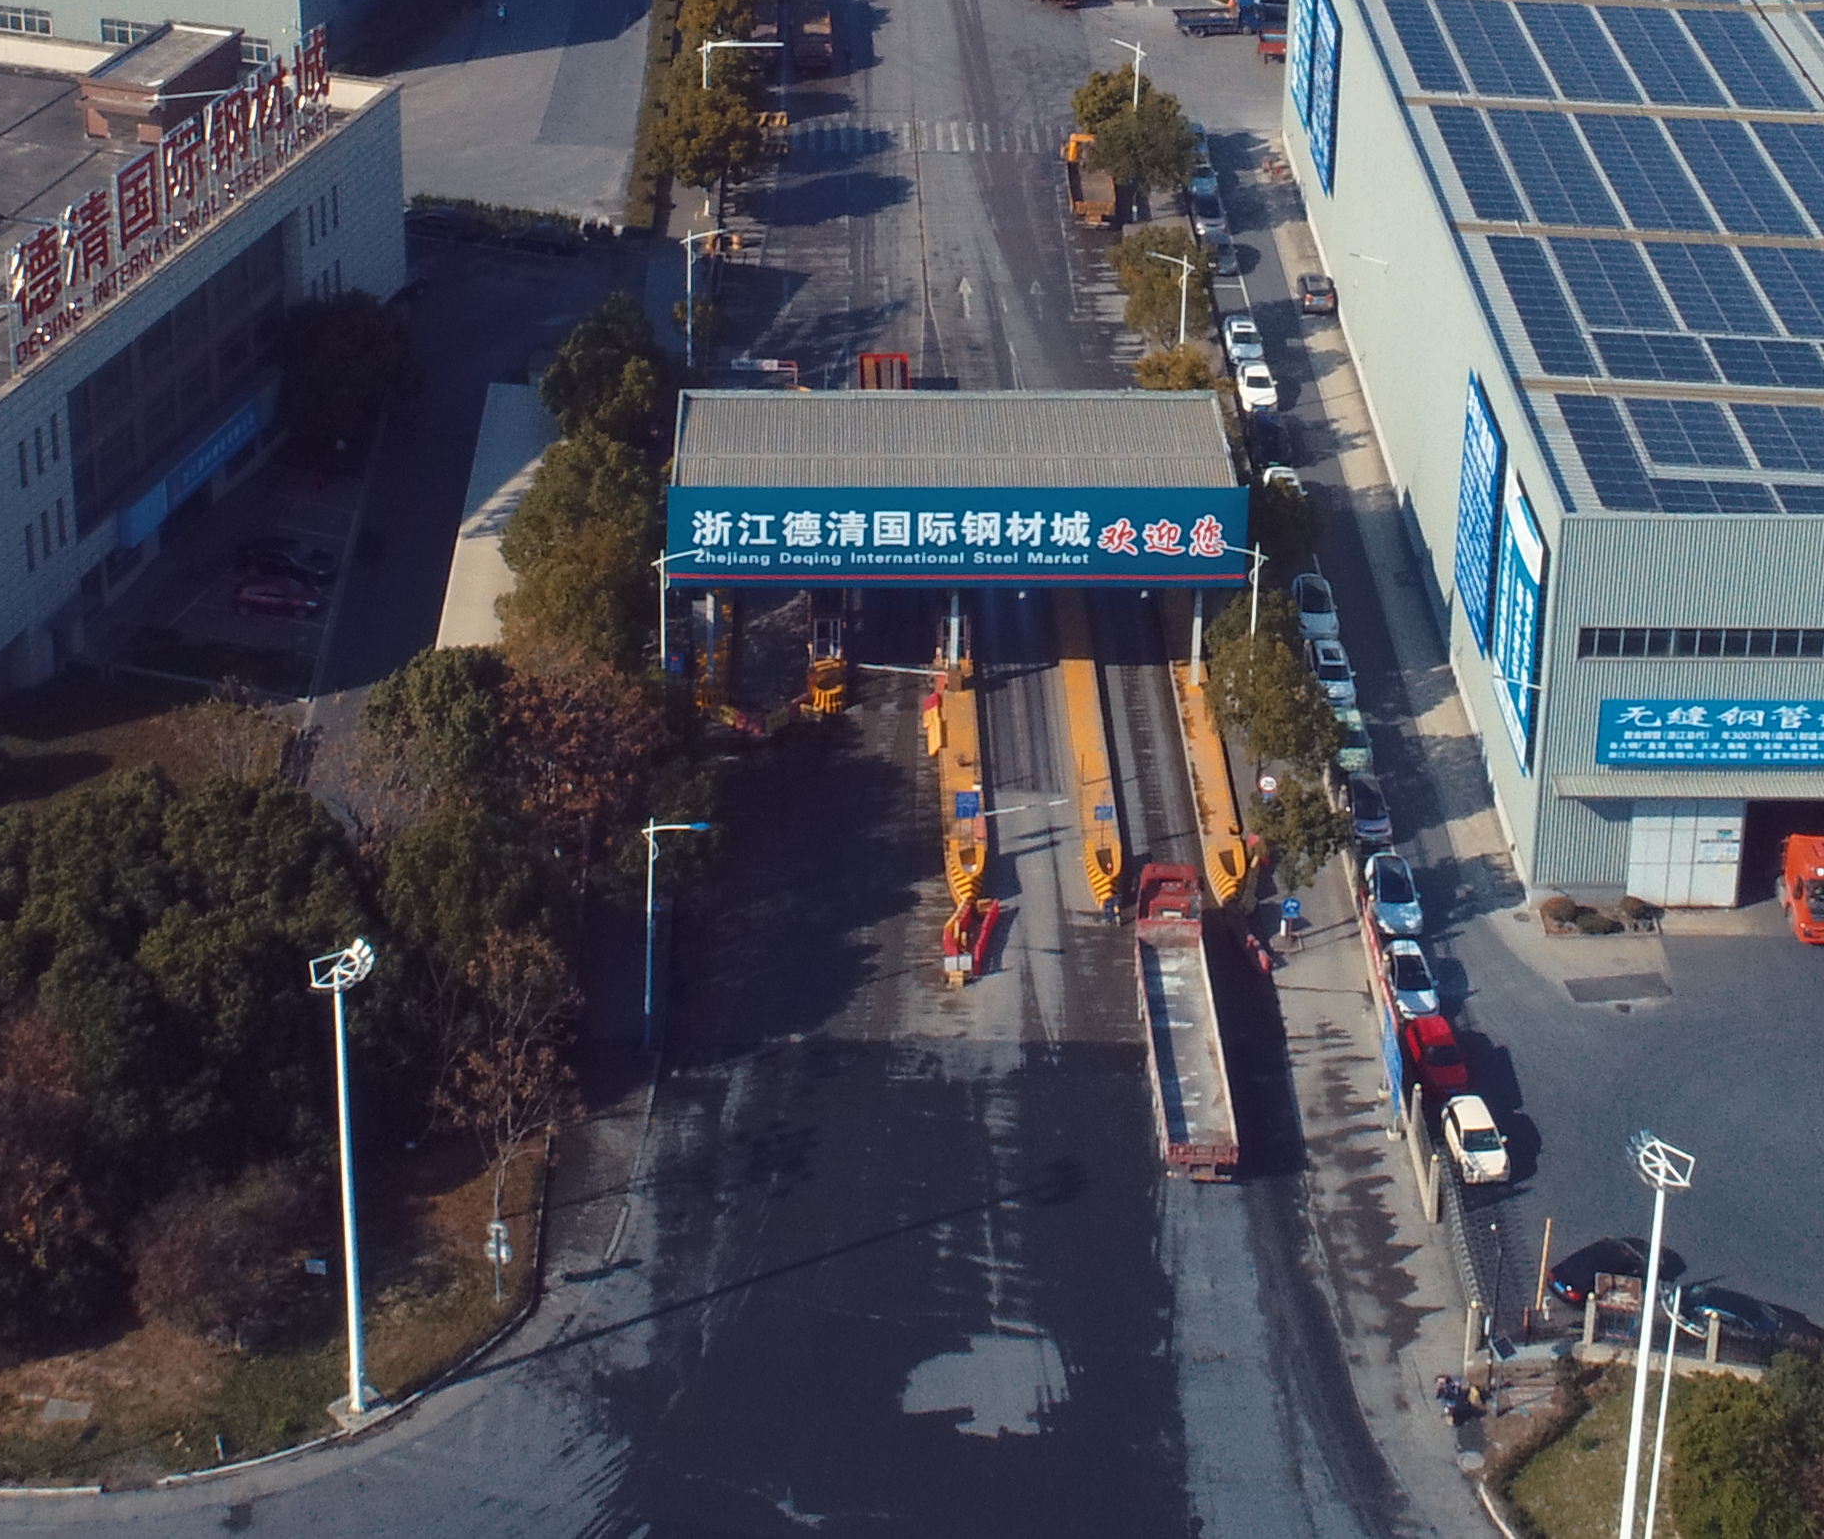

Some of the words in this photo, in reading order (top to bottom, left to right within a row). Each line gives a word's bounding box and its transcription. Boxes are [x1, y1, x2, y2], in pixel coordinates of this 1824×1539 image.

[10, 23, 330, 326] 德清国际钢材城
[92, 194, 221, 307] INTERNATIONAL
[692, 509, 1091, 549] 浙江德清国际钢材城
[1097, 515, 1227, 557] 欢迎您
[694, 550, 770, 568] Zhejiang
[779, 551, 842, 568] Deqing
[850, 550, 965, 565] International
[974, 551, 1019, 565] Steel
[1027, 551, 1090, 565] Market
[1615, 704, 1813, 729] 无缝钢管
